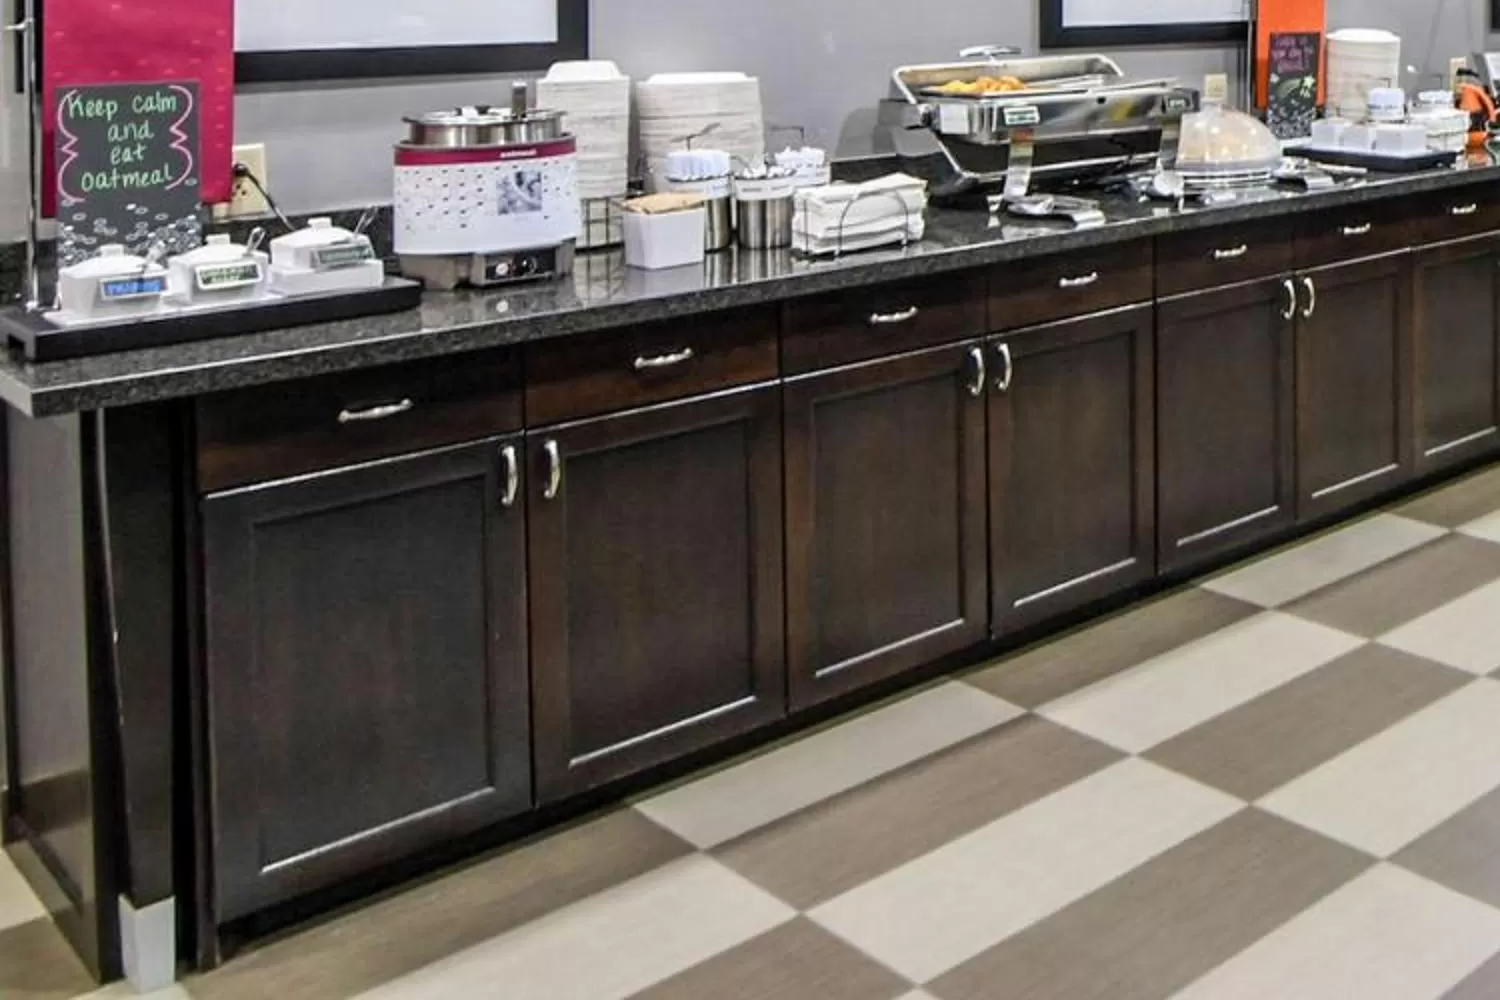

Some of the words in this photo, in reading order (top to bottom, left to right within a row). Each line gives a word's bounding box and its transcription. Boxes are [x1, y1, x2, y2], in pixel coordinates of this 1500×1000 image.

[67, 94, 118, 121] Keep
[131, 91, 177, 113] calm
[107, 120, 154, 142] and
[110, 142, 147, 165] eat
